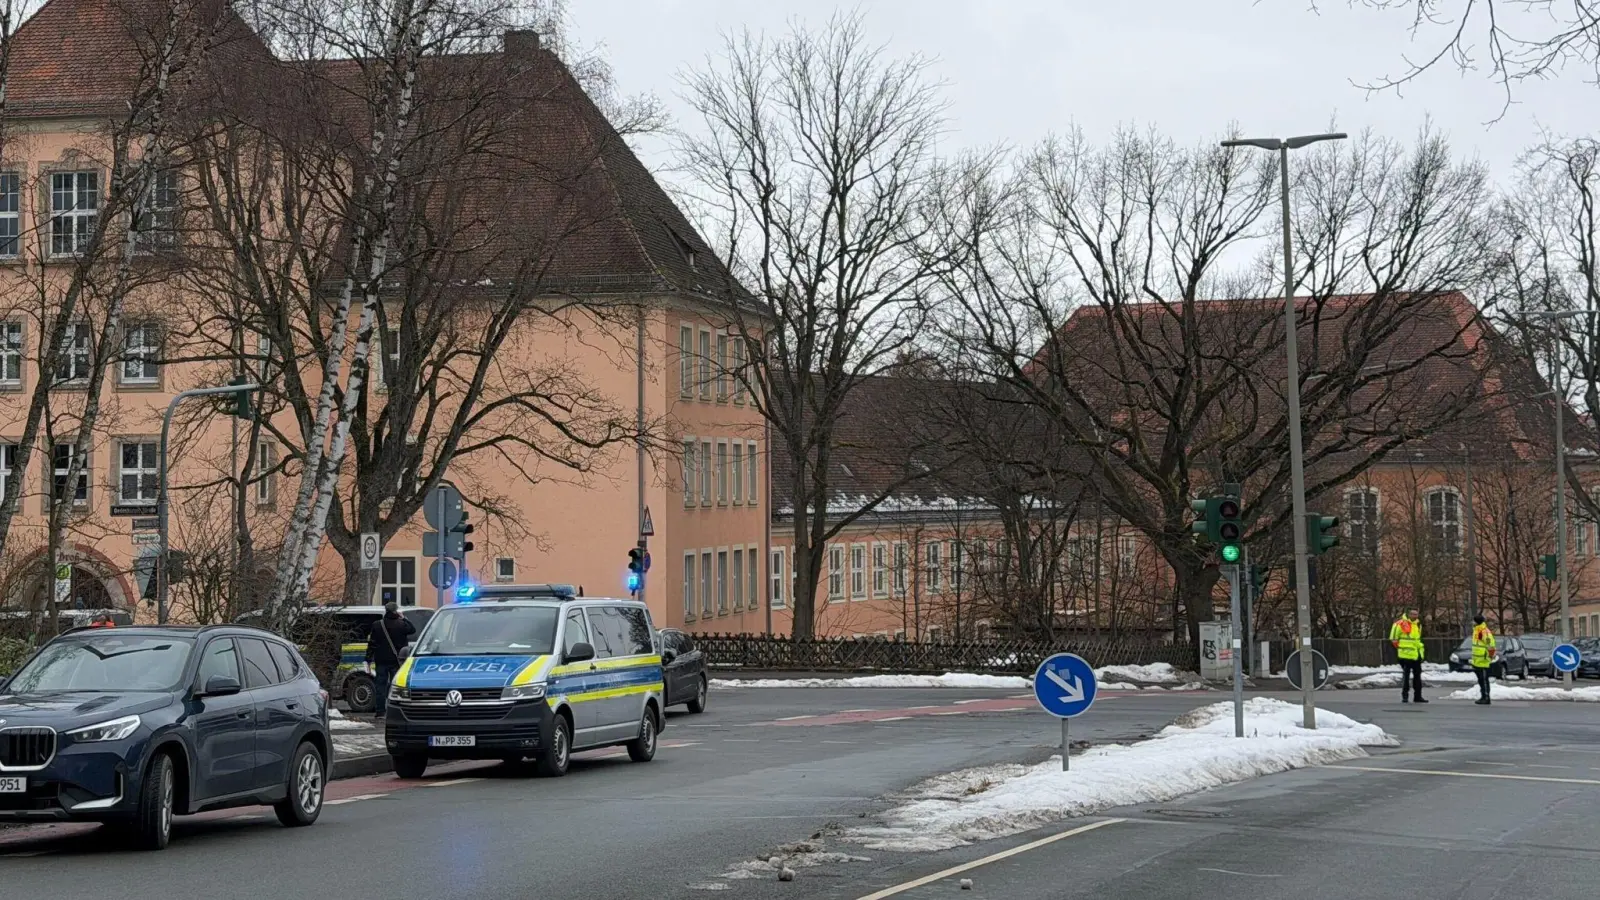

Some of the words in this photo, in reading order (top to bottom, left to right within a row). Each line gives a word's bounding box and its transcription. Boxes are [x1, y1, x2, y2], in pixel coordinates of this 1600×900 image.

[366, 542, 375, 554] 30
[423, 662, 507, 674] POLIZEI
[435, 736, 441, 745] N
[445, 736, 456, 745] PP
[457, 736, 471, 745] 355
[0, 778, 20, 791] 951
